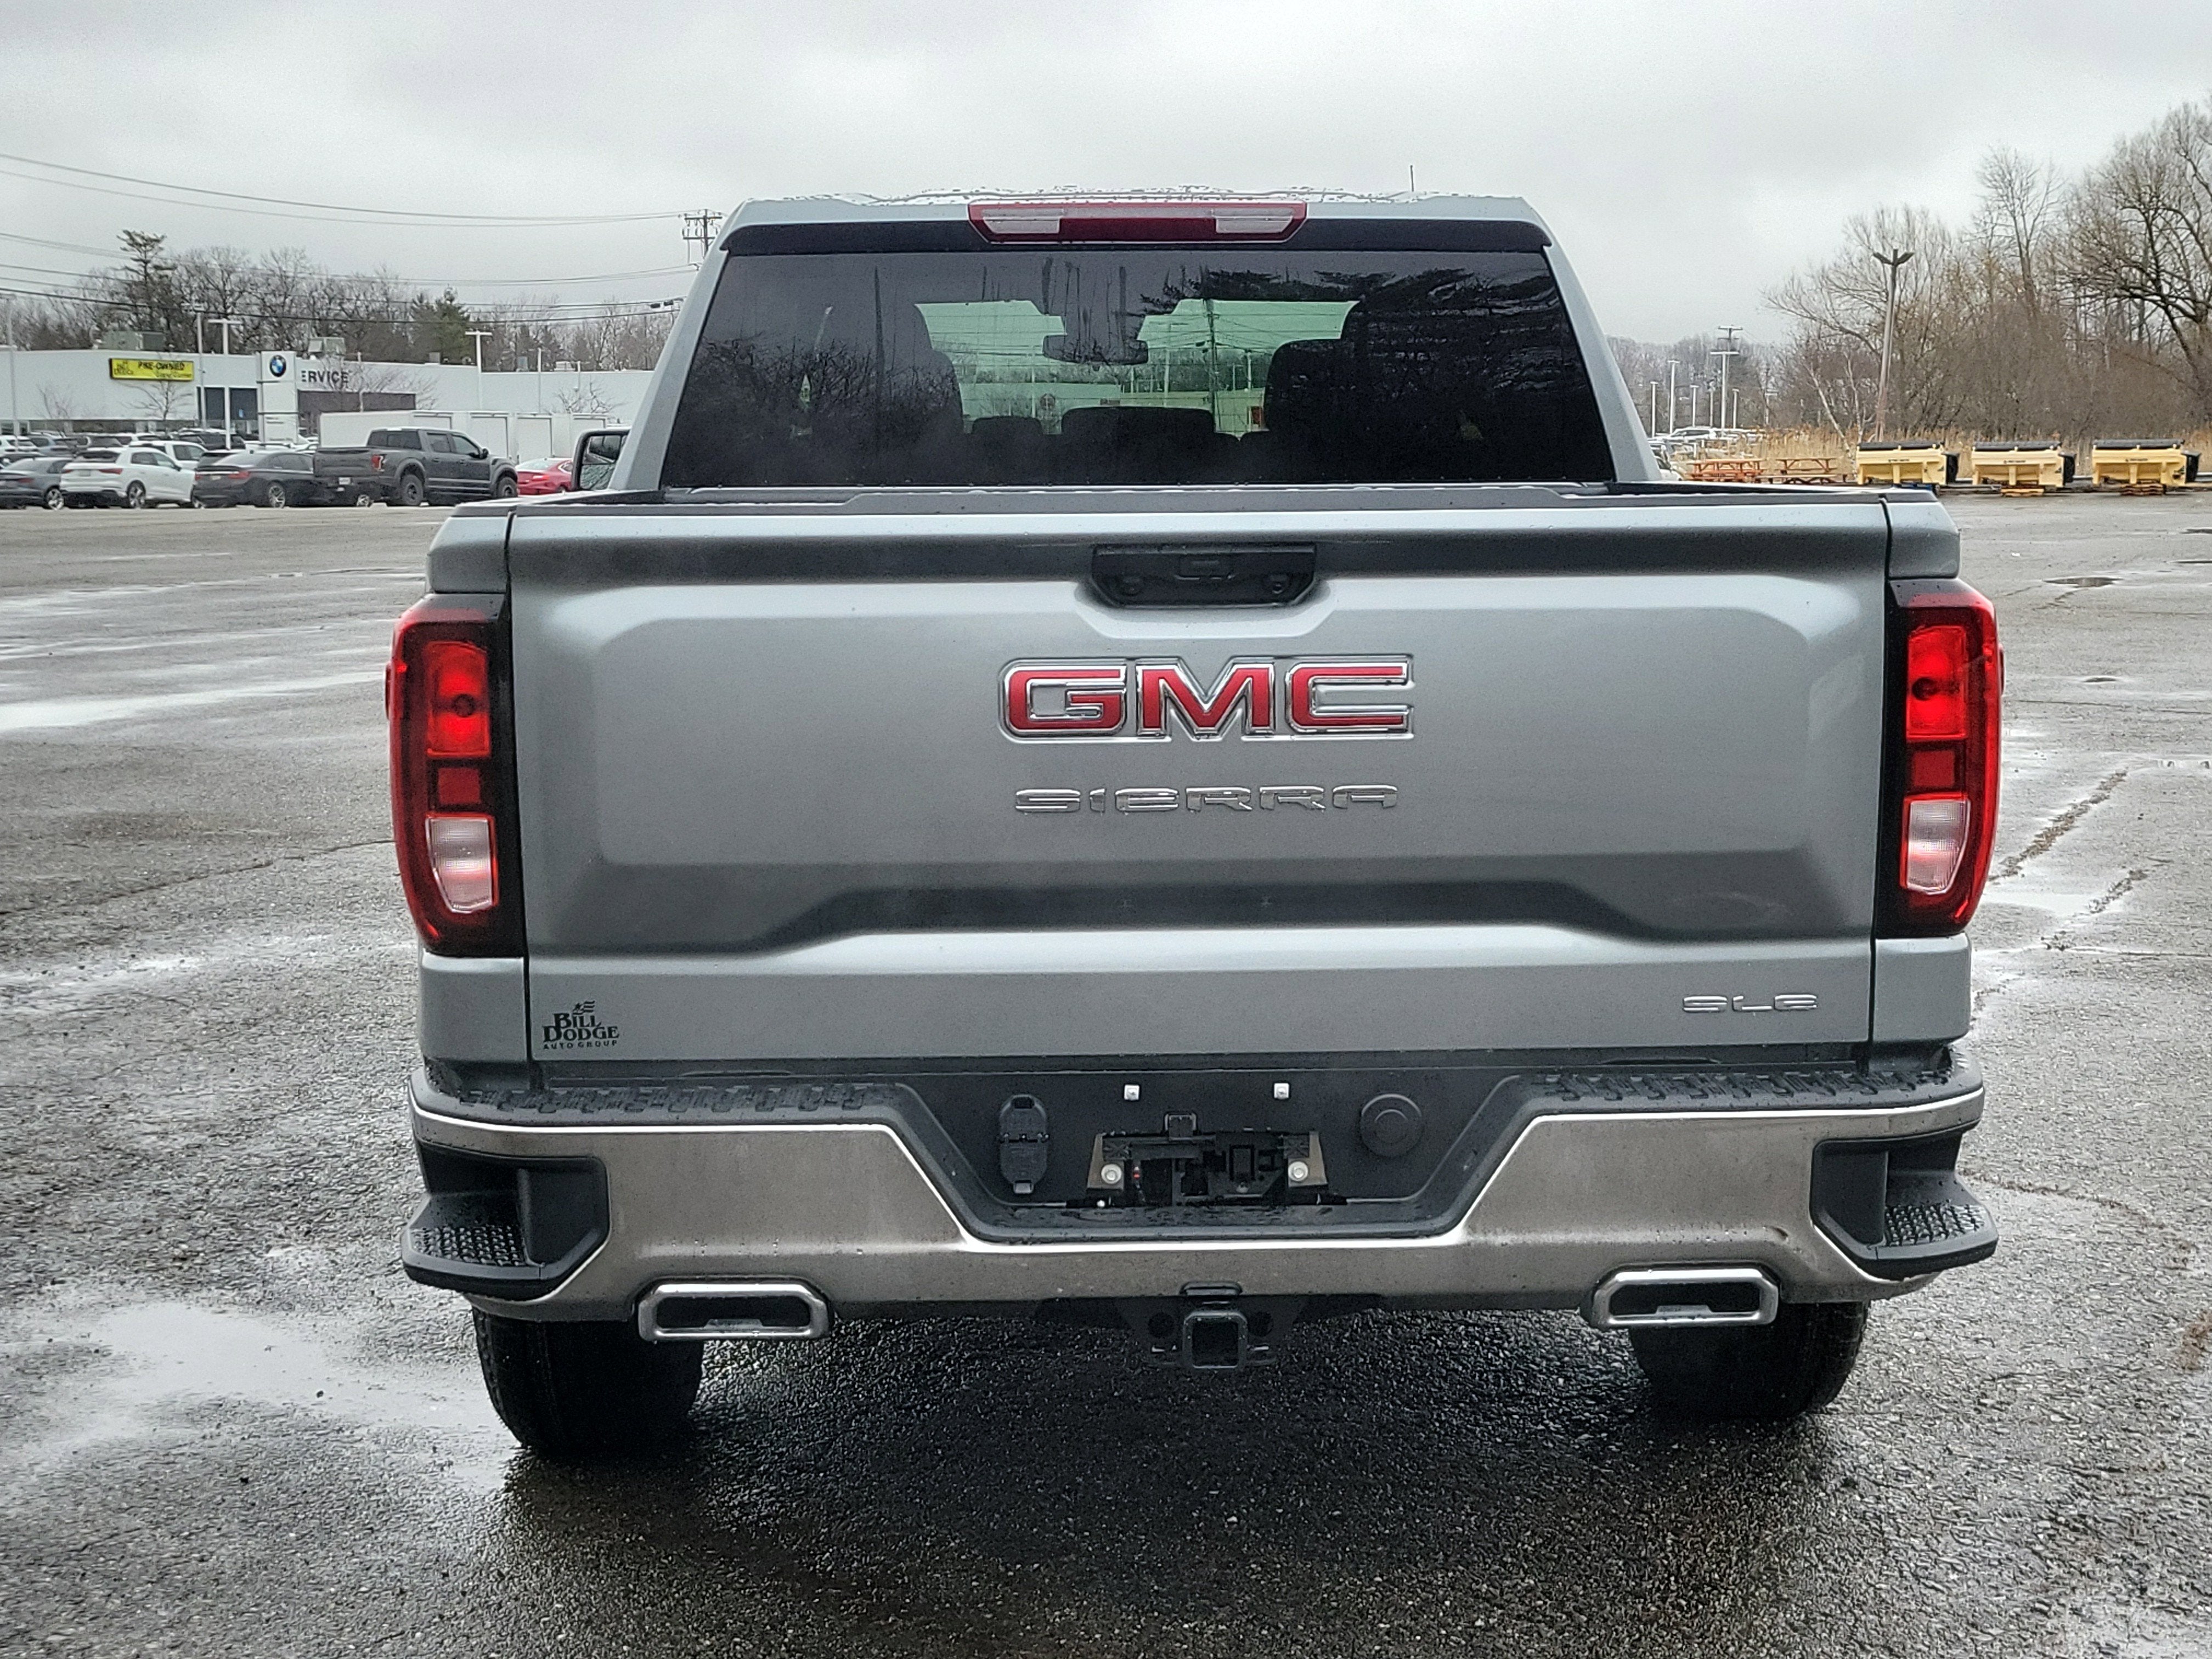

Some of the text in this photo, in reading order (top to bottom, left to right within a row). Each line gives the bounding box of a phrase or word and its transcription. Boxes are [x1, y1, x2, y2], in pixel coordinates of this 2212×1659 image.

[301, 370, 349, 383] ERVICE
[1000, 656, 1414, 742] GMC
[1015, 785, 1398, 812] SIERRA
[1683, 993, 1817, 1012] SLE
[552, 1013, 602, 1029] BILL
[542, 1025, 620, 1042] DODGE
